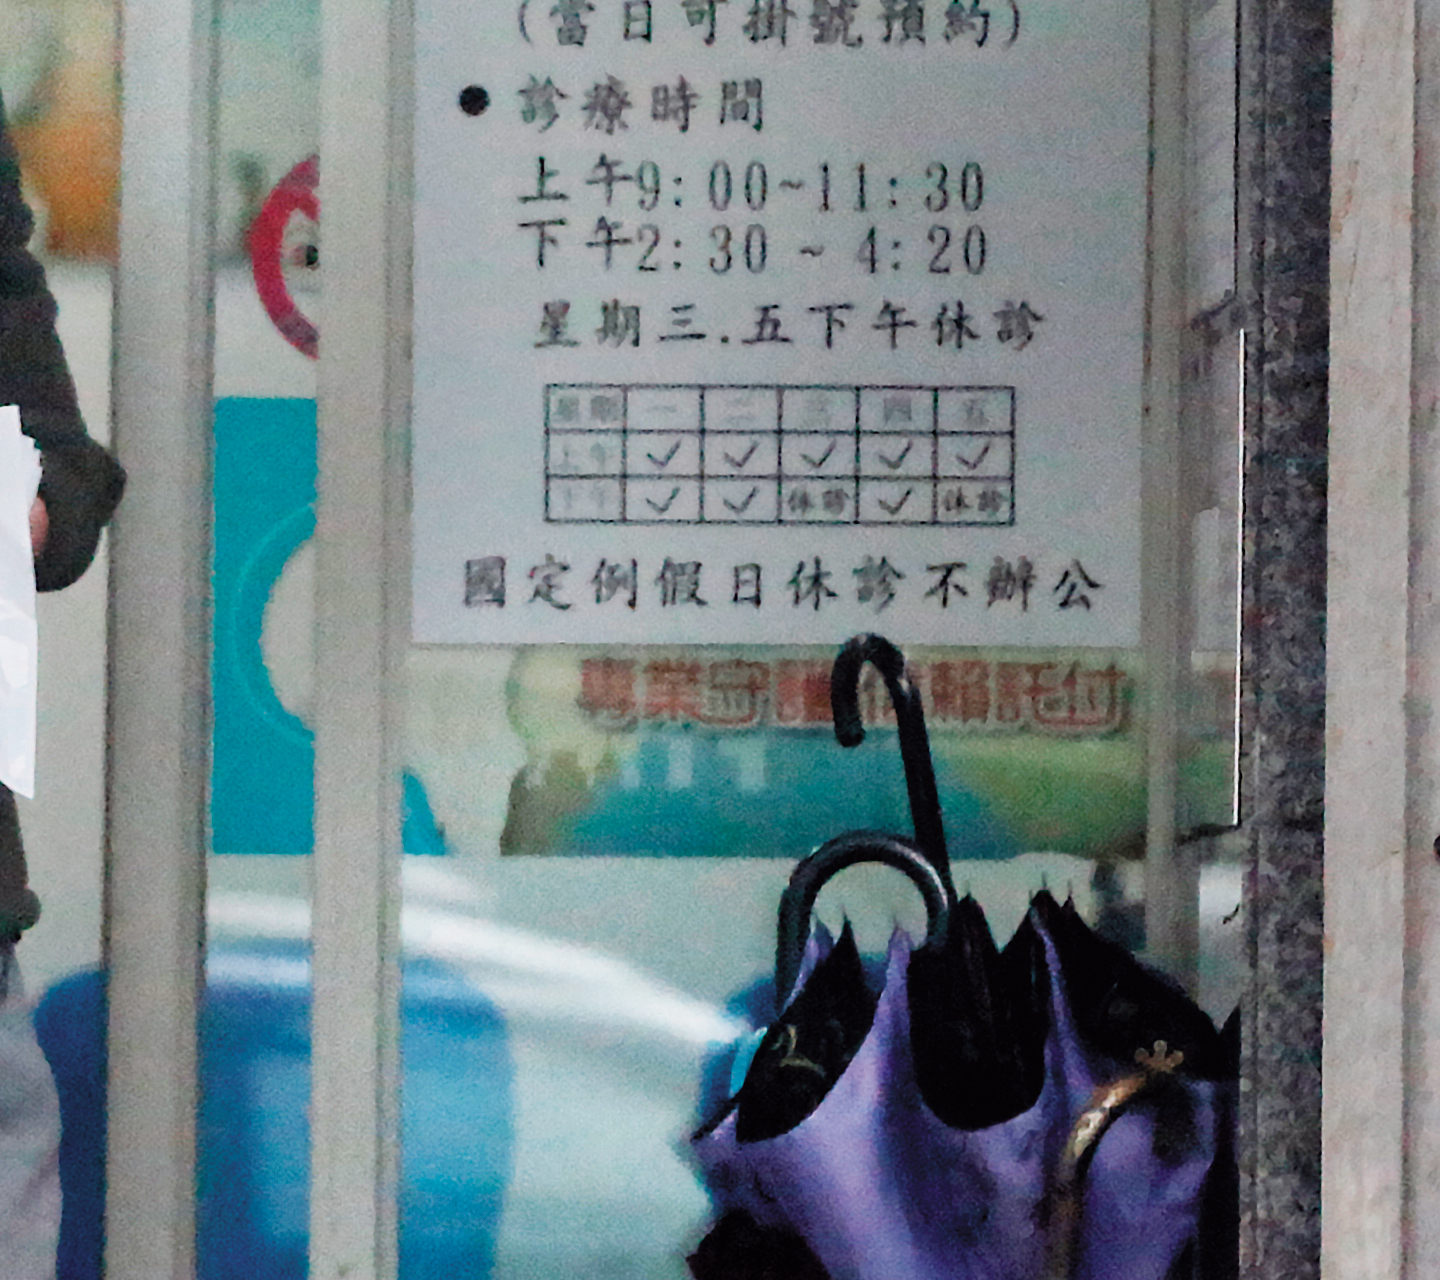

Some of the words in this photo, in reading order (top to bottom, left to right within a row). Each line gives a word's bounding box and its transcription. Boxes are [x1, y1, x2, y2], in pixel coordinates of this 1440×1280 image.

[518, 73, 764, 134] 診療時間
[463, 556, 1103, 610] 國定例假日休診不辦公
